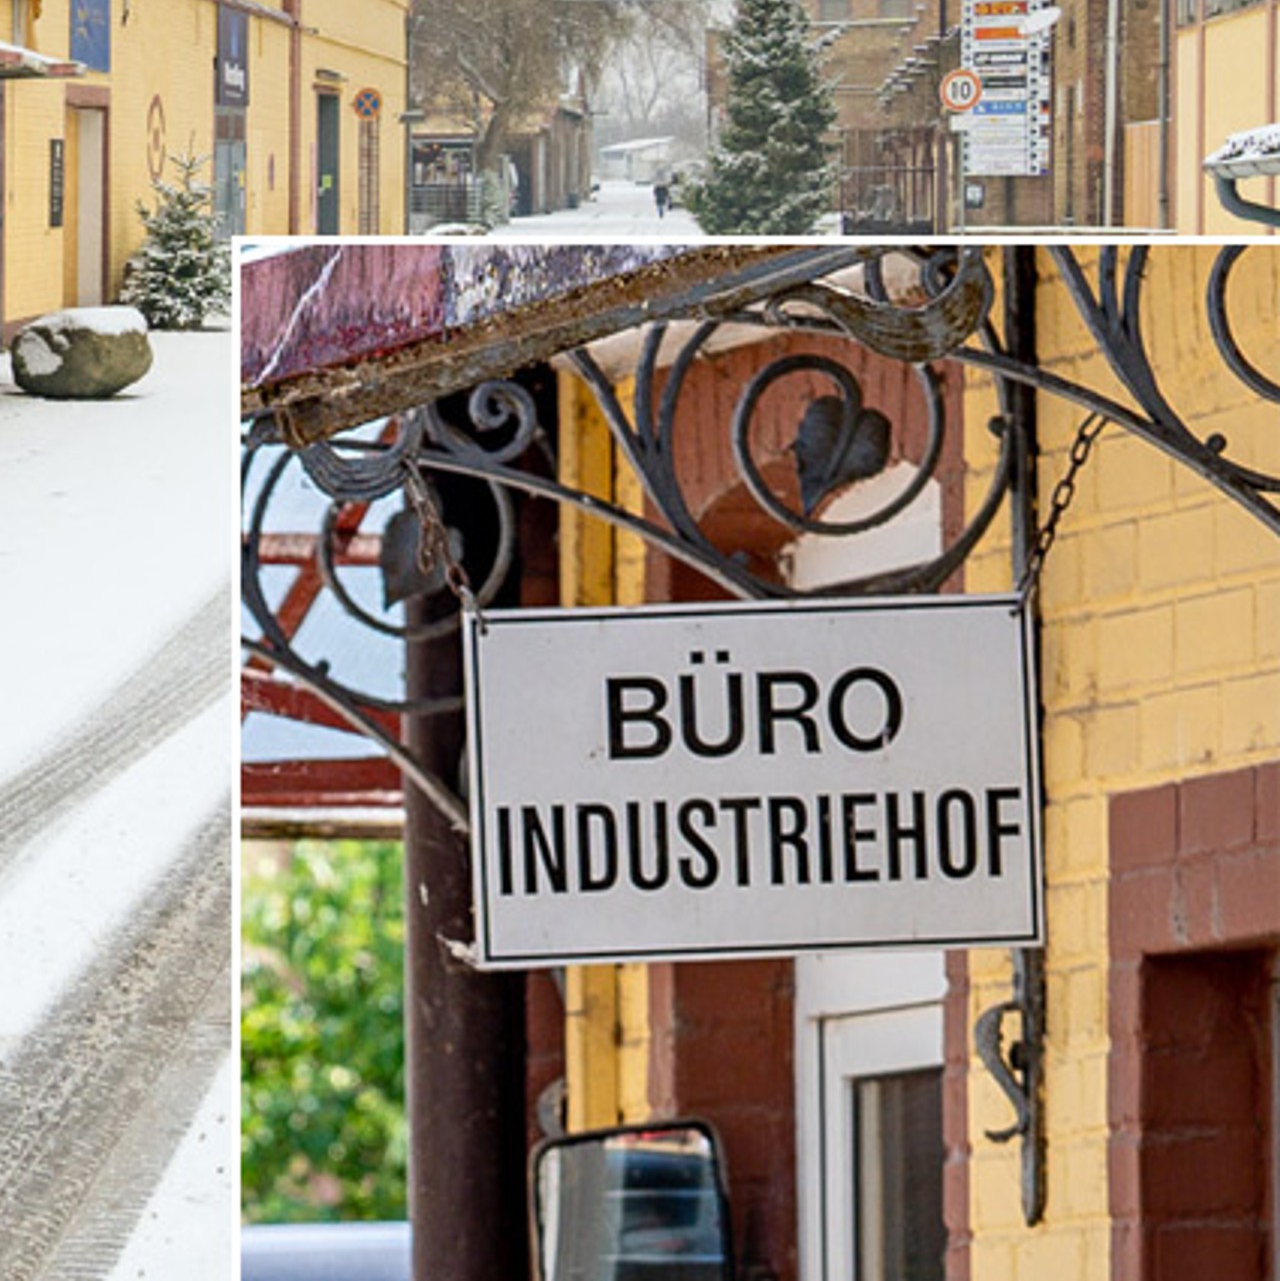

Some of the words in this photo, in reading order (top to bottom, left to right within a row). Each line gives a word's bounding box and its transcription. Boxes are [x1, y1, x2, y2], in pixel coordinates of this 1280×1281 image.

[951, 81, 972, 101] 10
[605, 650, 904, 761] BÜRO
[496, 787, 1022, 896] INDUSTRIEHOF
